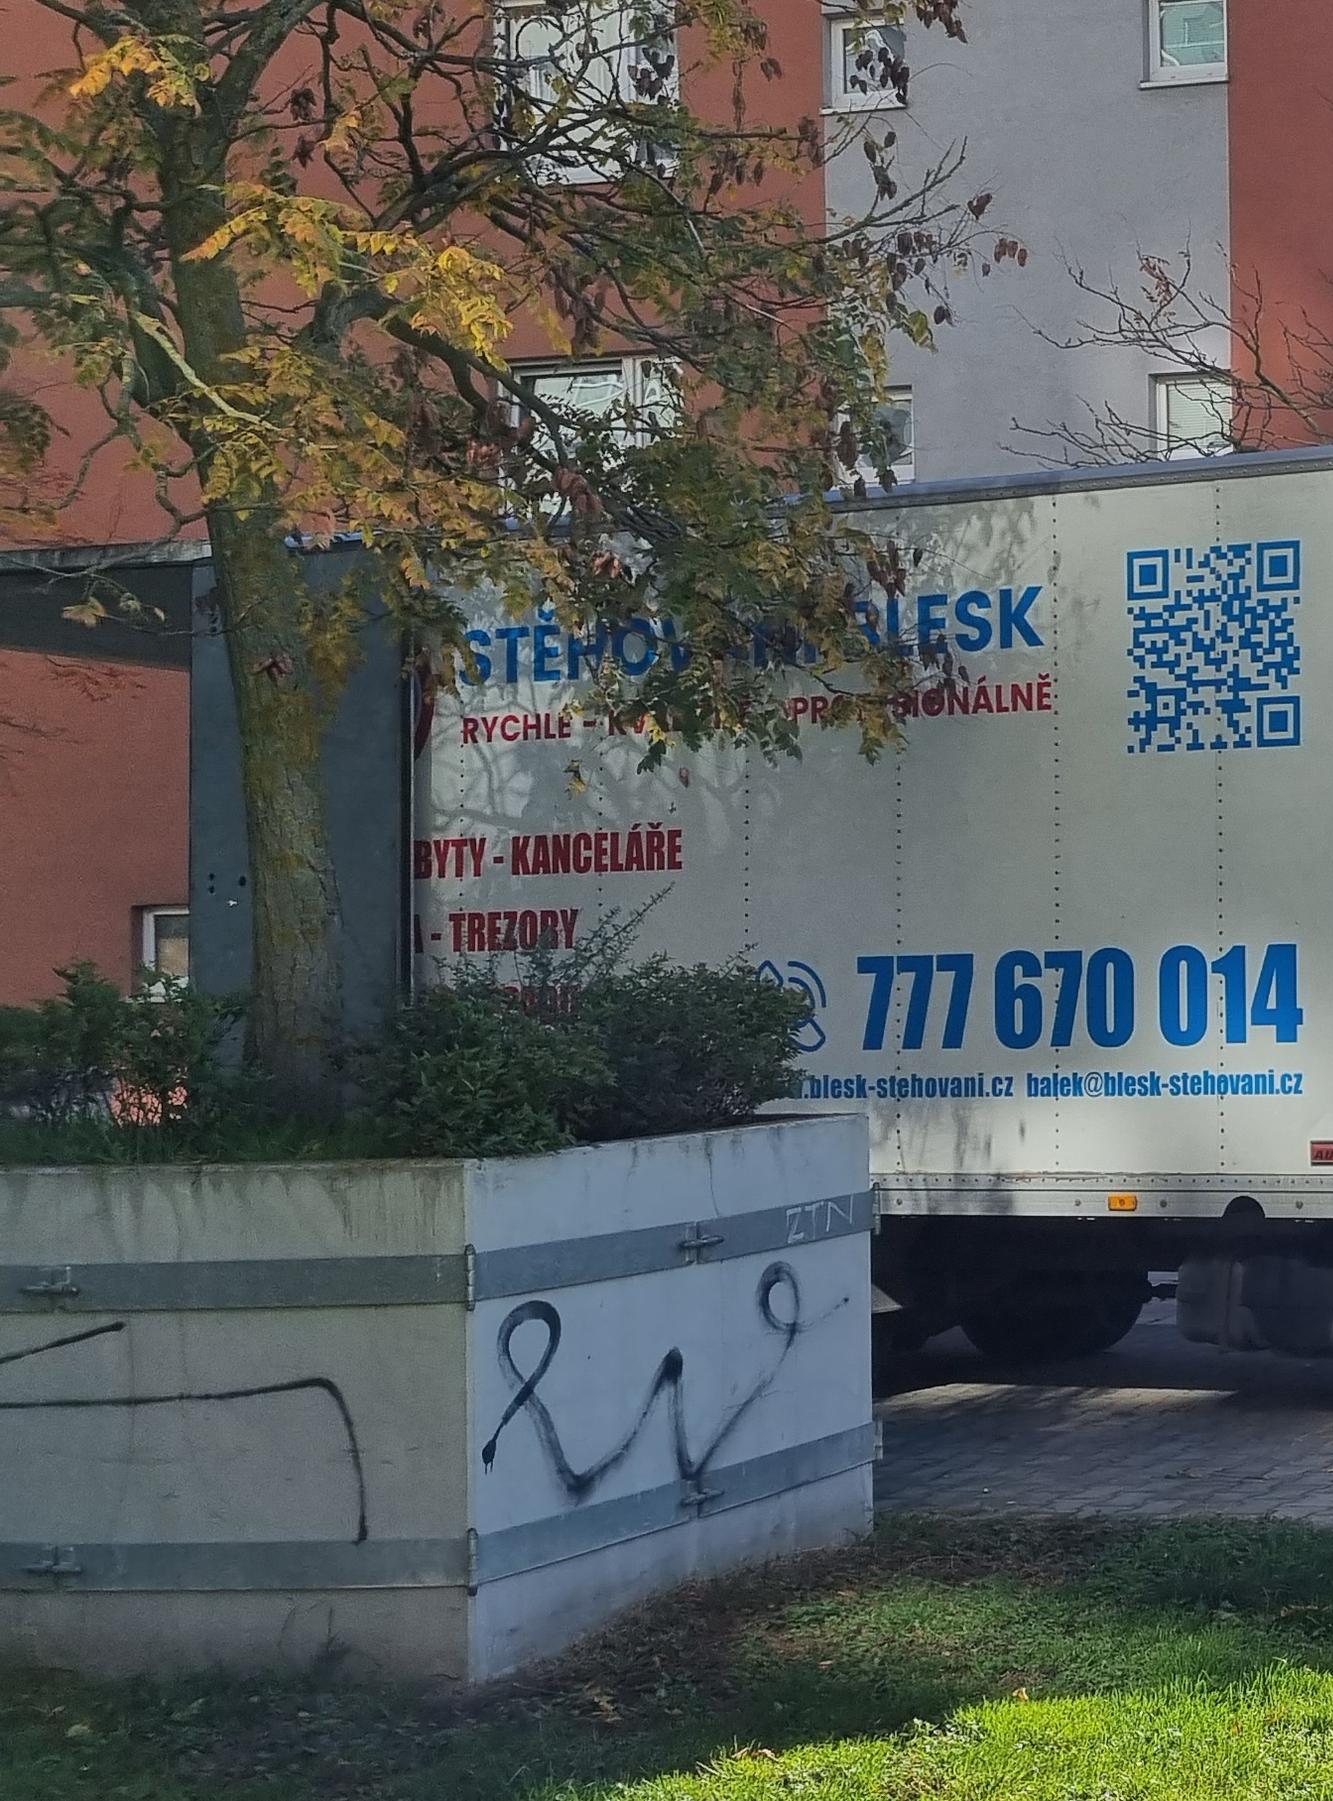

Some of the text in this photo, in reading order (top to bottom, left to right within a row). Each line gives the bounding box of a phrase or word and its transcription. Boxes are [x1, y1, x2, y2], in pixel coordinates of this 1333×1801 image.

[462, 711, 572, 745] RYCHLE
[414, 837, 487, 880] BYTY
[511, 822, 683, 876] KANCELÁŘE
[449, 908, 579, 953] TREZORY
[856, 943, 1303, 1051] 777 670 014
[801, 1069, 1304, 1100] .blesk-stehovani.cz balek@blesk-stehovani.cz
